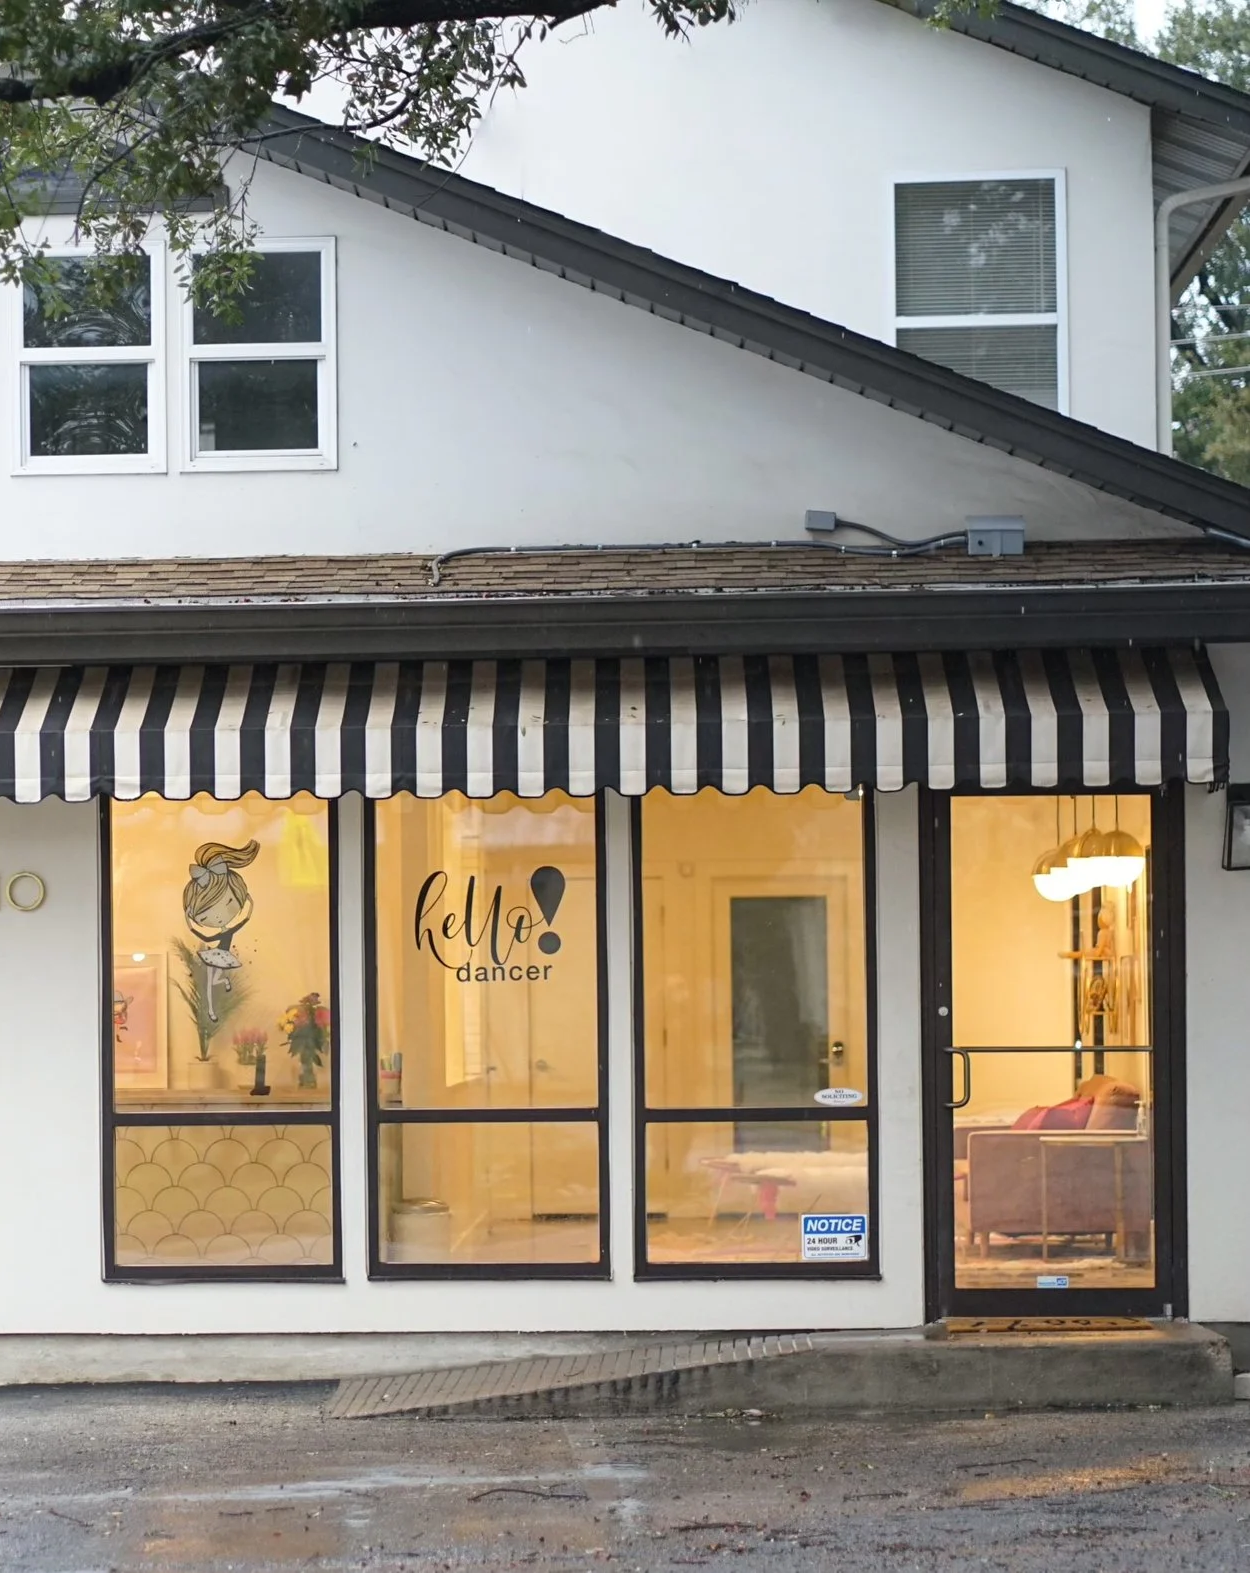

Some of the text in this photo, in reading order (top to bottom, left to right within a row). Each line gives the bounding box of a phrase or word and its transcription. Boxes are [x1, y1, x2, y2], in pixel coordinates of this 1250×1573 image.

[456, 962, 553, 982] dancer
[806, 1218, 863, 1232] NOTICE
[807, 1237, 838, 1245] 24 HOUR
